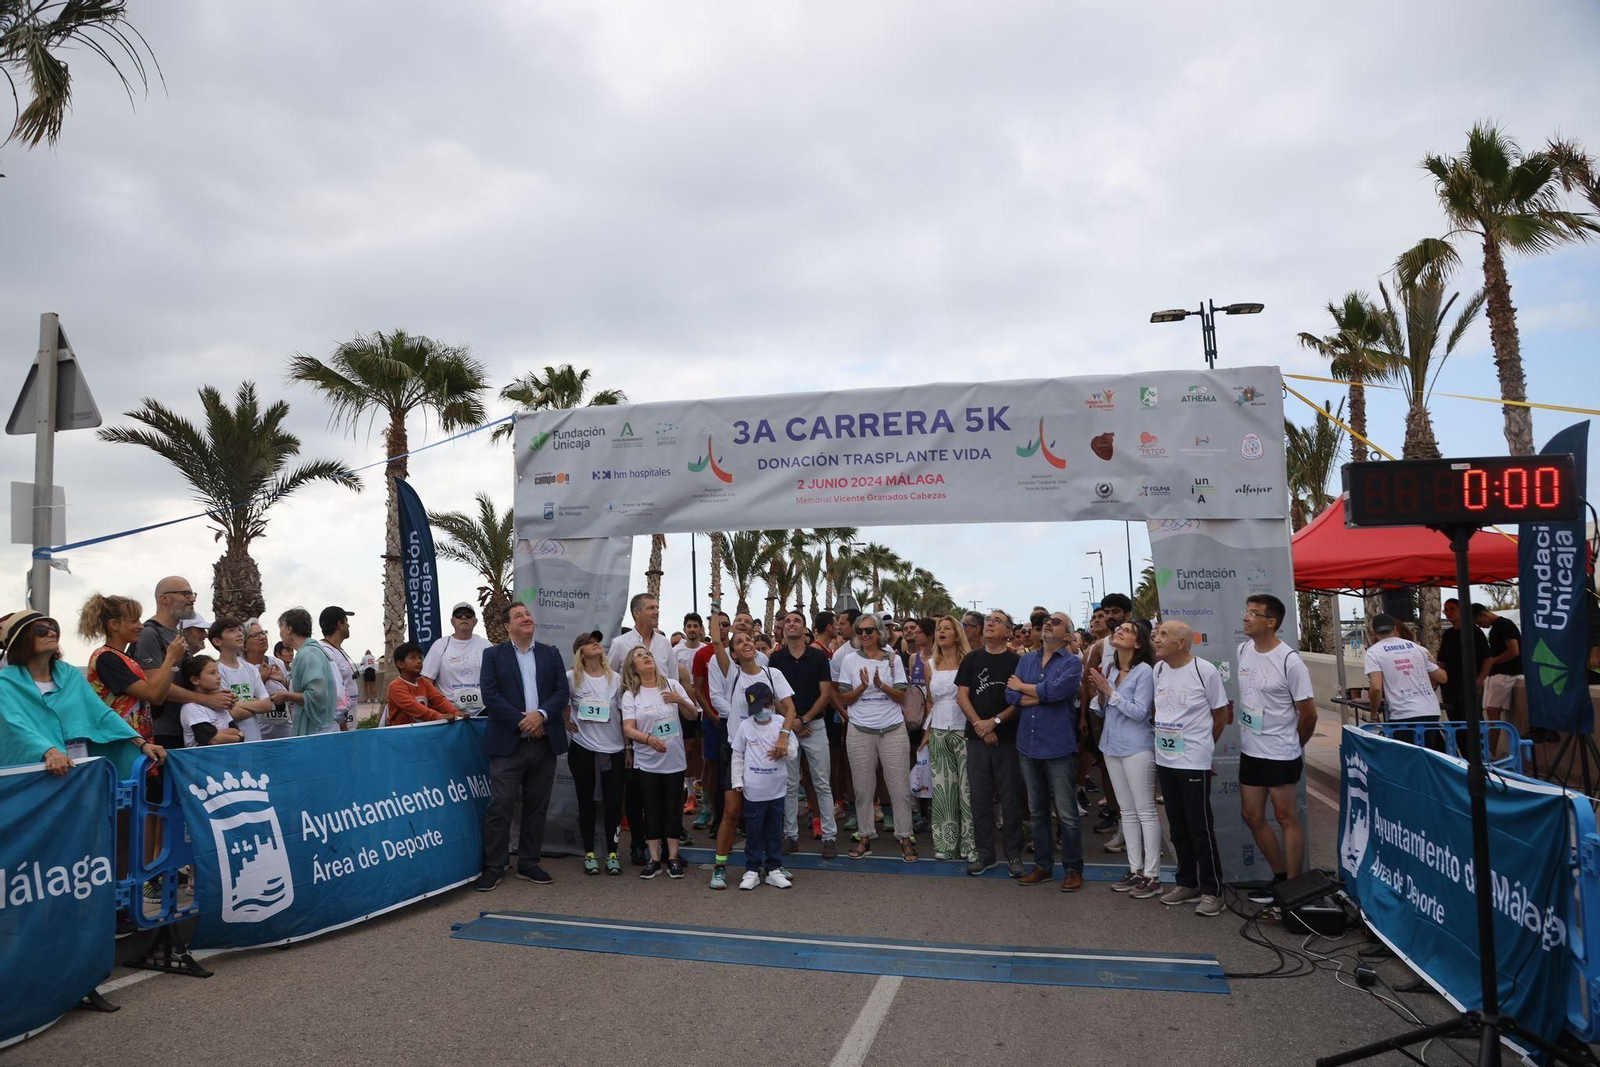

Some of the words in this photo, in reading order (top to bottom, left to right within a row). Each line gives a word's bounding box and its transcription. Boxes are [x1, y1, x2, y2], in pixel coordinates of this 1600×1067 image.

[732, 419, 777, 445] 3A
[785, 409, 955, 442] CARRERA
[965, 406, 1012, 433] 5K
[553, 426, 606, 440] Fundación
[553, 438, 591, 451] Unicaja
[757, 452, 839, 470] DONACIÓN
[843, 450, 949, 466] TRASPLANTE
[952, 447, 992, 462] VIDA
[614, 469, 627, 480] hm
[629, 467, 671, 479] hospitales
[797, 480, 805, 490] 2
[807, 478, 848, 489] JUNIO
[851, 476, 883, 488] 2024
[885, 472, 945, 486] MÁLAGA
[1463, 467, 1560, 510] 0:00
[833, 494, 865, 503] Vicente
[867, 493, 908, 501] Granados
[909, 491, 947, 500] Cabezas
[1197, 494, 1206, 504] A
[1176, 567, 1236, 579] Fundación
[1532, 525, 1552, 629] Fundaci
[1178, 580, 1221, 592] Unicaja
[1551, 530, 1577, 630] Unicaja
[539, 587, 590, 600] Fundación
[419, 562, 433, 643] Unicaja
[539, 597, 575, 610] Unicaja
[1182, 608, 1213, 616] hospitales
[460, 694, 478, 703] 600
[588, 706, 600, 715] 31
[657, 723, 671, 733] 13
[1161, 738, 1175, 748] 32
[301, 786, 445, 844] Ayuntamiento
[447, 779, 468, 803] de
[466, 774, 492, 798] Mál
[1374, 806, 1460, 883] Ayuntamiento
[312, 854, 355, 885] Área
[358, 847, 380, 869] de
[381, 829, 444, 862] Deporte
[1369, 850, 1392, 886] Área
[1393, 868, 1404, 894] de
